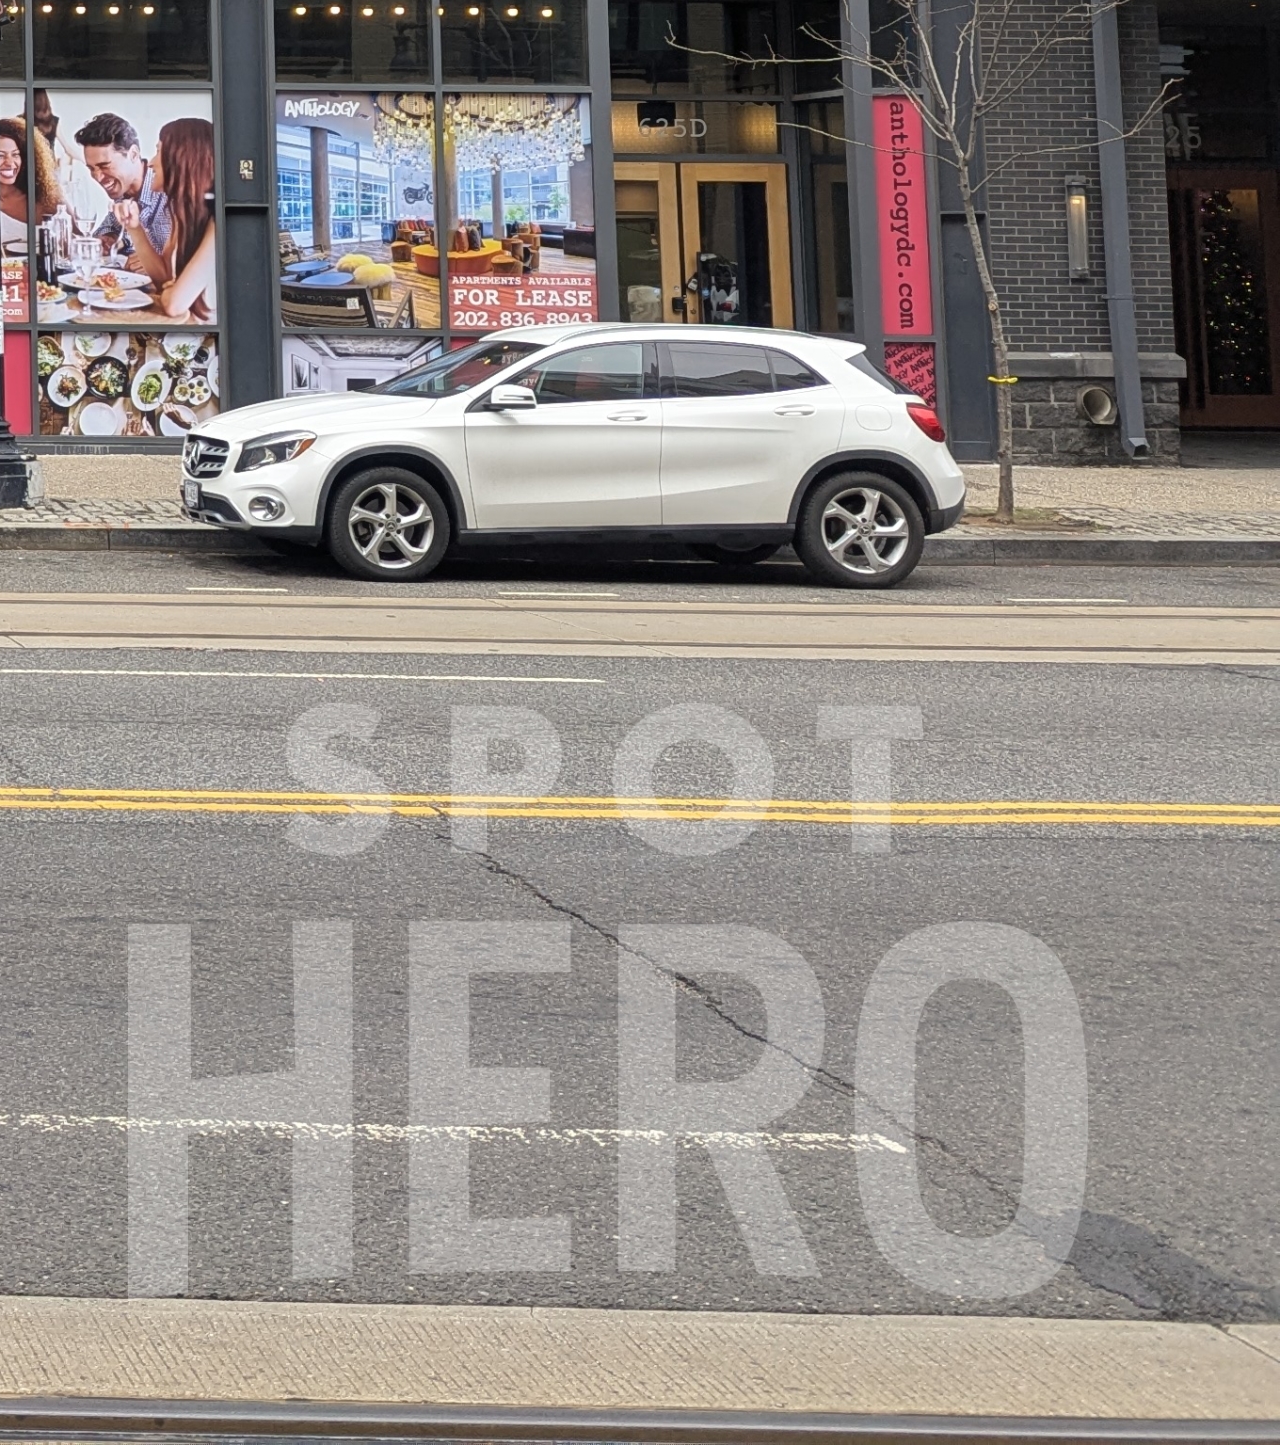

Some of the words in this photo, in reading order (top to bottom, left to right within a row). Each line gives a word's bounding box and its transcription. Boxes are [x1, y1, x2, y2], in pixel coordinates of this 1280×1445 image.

[284, 97, 361, 118] ANTHOLOGY
[639, 117, 708, 139] 625D
[889, 101, 915, 330] anthologydc.com
[452, 276, 522, 285] APARTMENTS
[528, 277, 592, 286] AVAILABLE
[453, 289, 500, 306] FOR
[515, 289, 593, 307] LEASE
[453, 311, 593, 327] 202.836.8943
